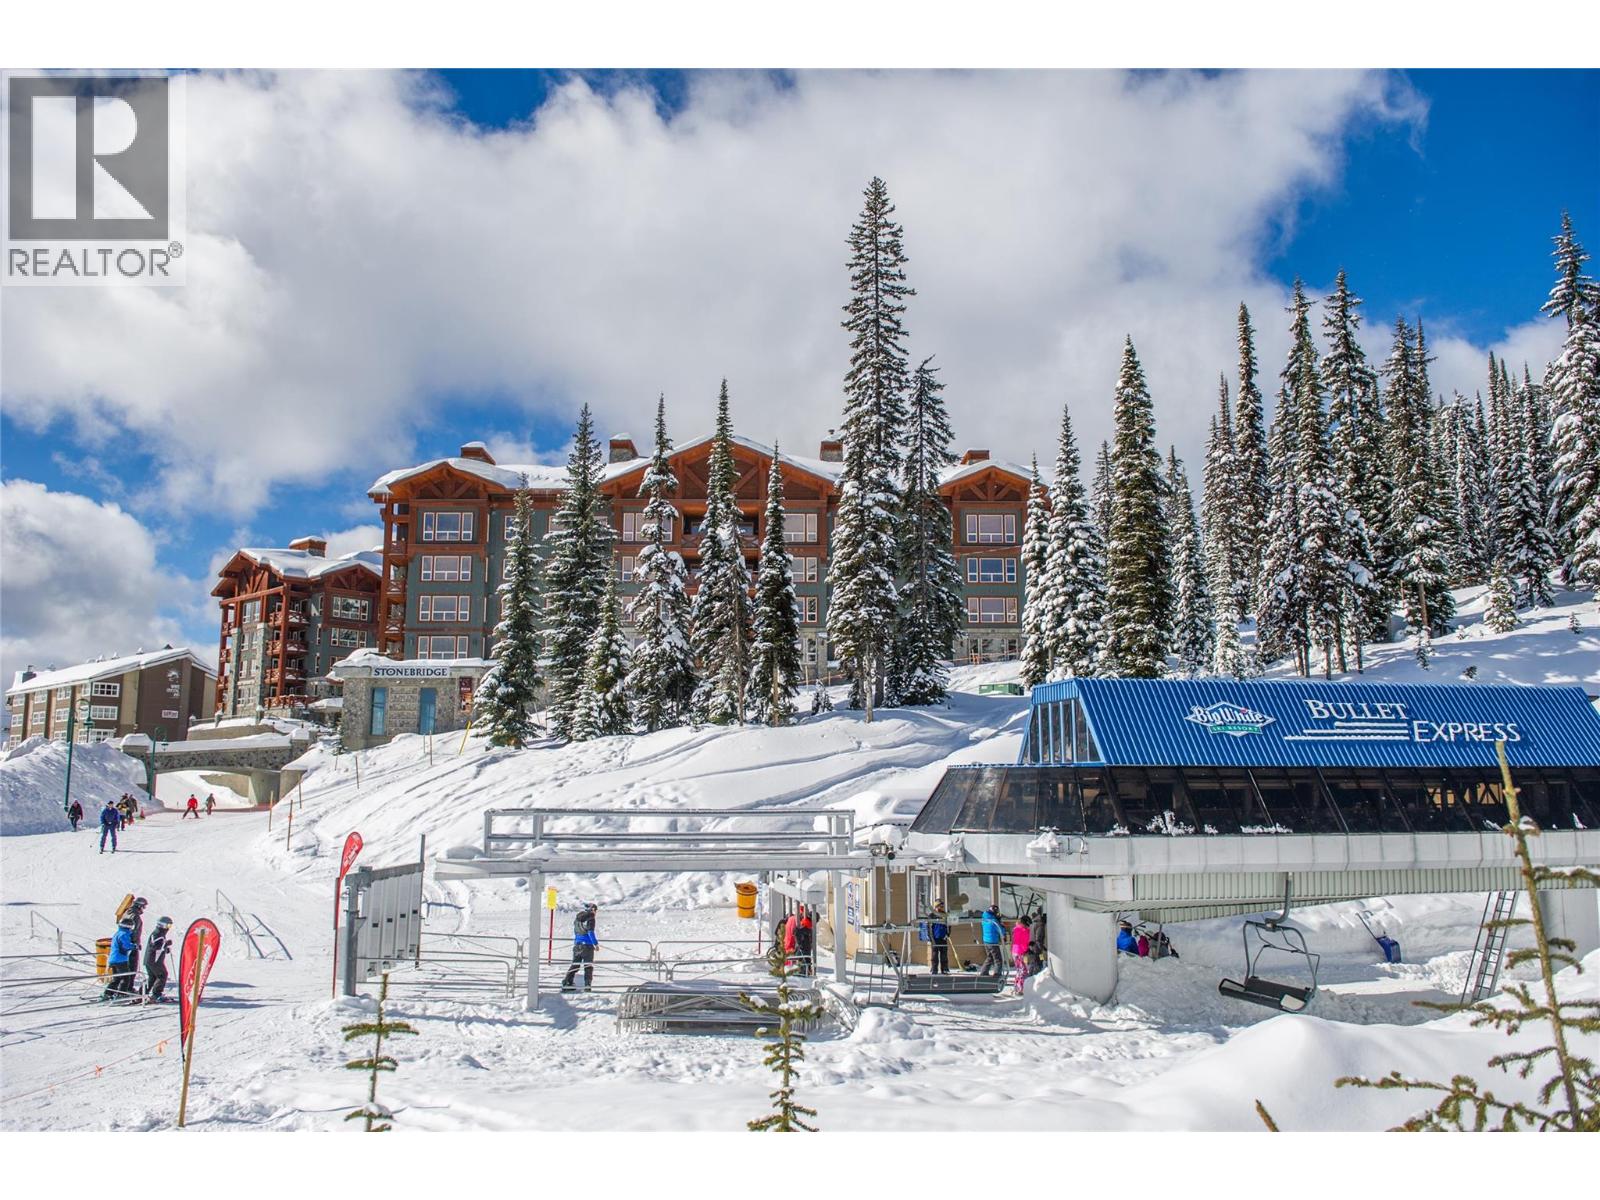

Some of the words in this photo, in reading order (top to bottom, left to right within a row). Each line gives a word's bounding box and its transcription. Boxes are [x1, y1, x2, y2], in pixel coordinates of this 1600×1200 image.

[374, 667, 447, 677] STONEBRIDGE
[1303, 699, 1409, 719] BULLET
[1413, 720, 1521, 742] EXPRESS
